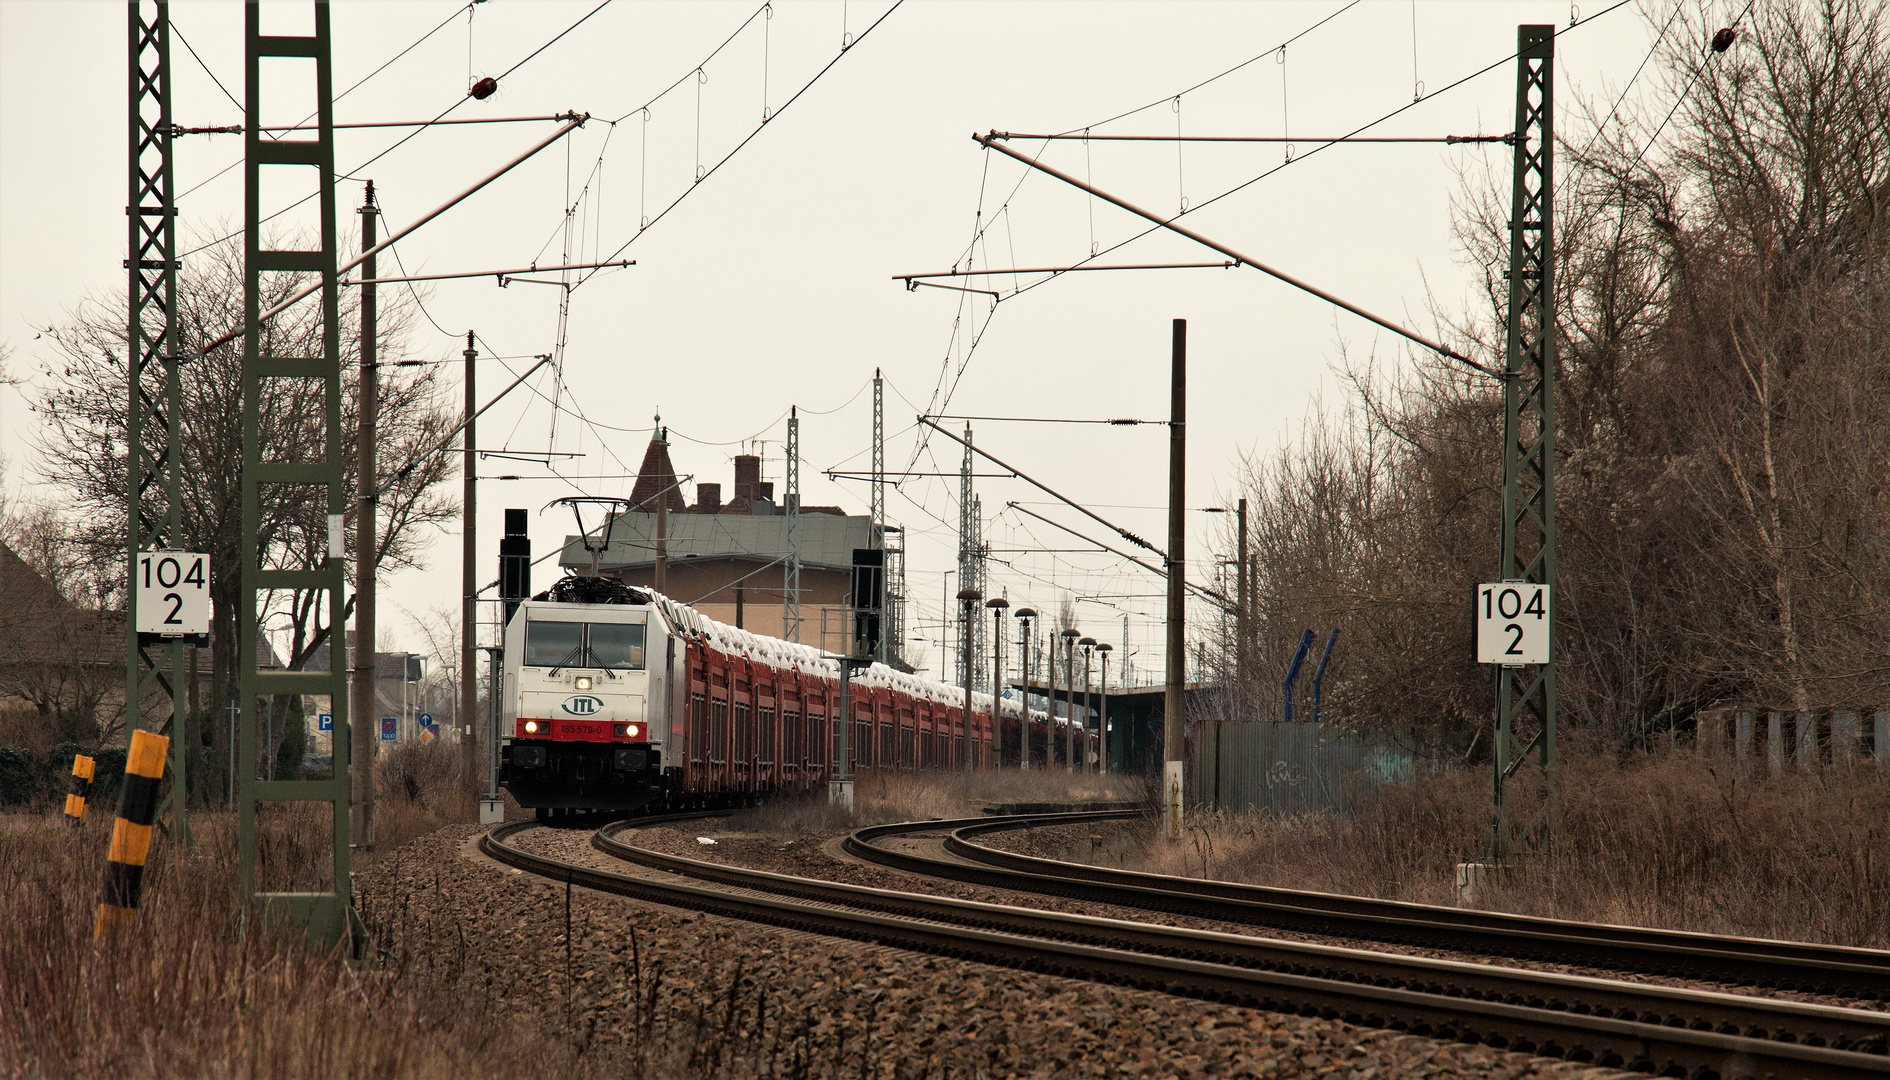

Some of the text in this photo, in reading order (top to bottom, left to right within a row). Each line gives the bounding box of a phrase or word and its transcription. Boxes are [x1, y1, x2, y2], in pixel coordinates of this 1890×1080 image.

[141, 557, 205, 589] 104
[163, 593, 183, 624] 2
[1482, 588, 1545, 619] 104
[1504, 623, 1524, 655] 2
[573, 698, 594, 712] ITL
[322, 715, 332, 729] P
[561, 724, 602, 735] 185 579-0
